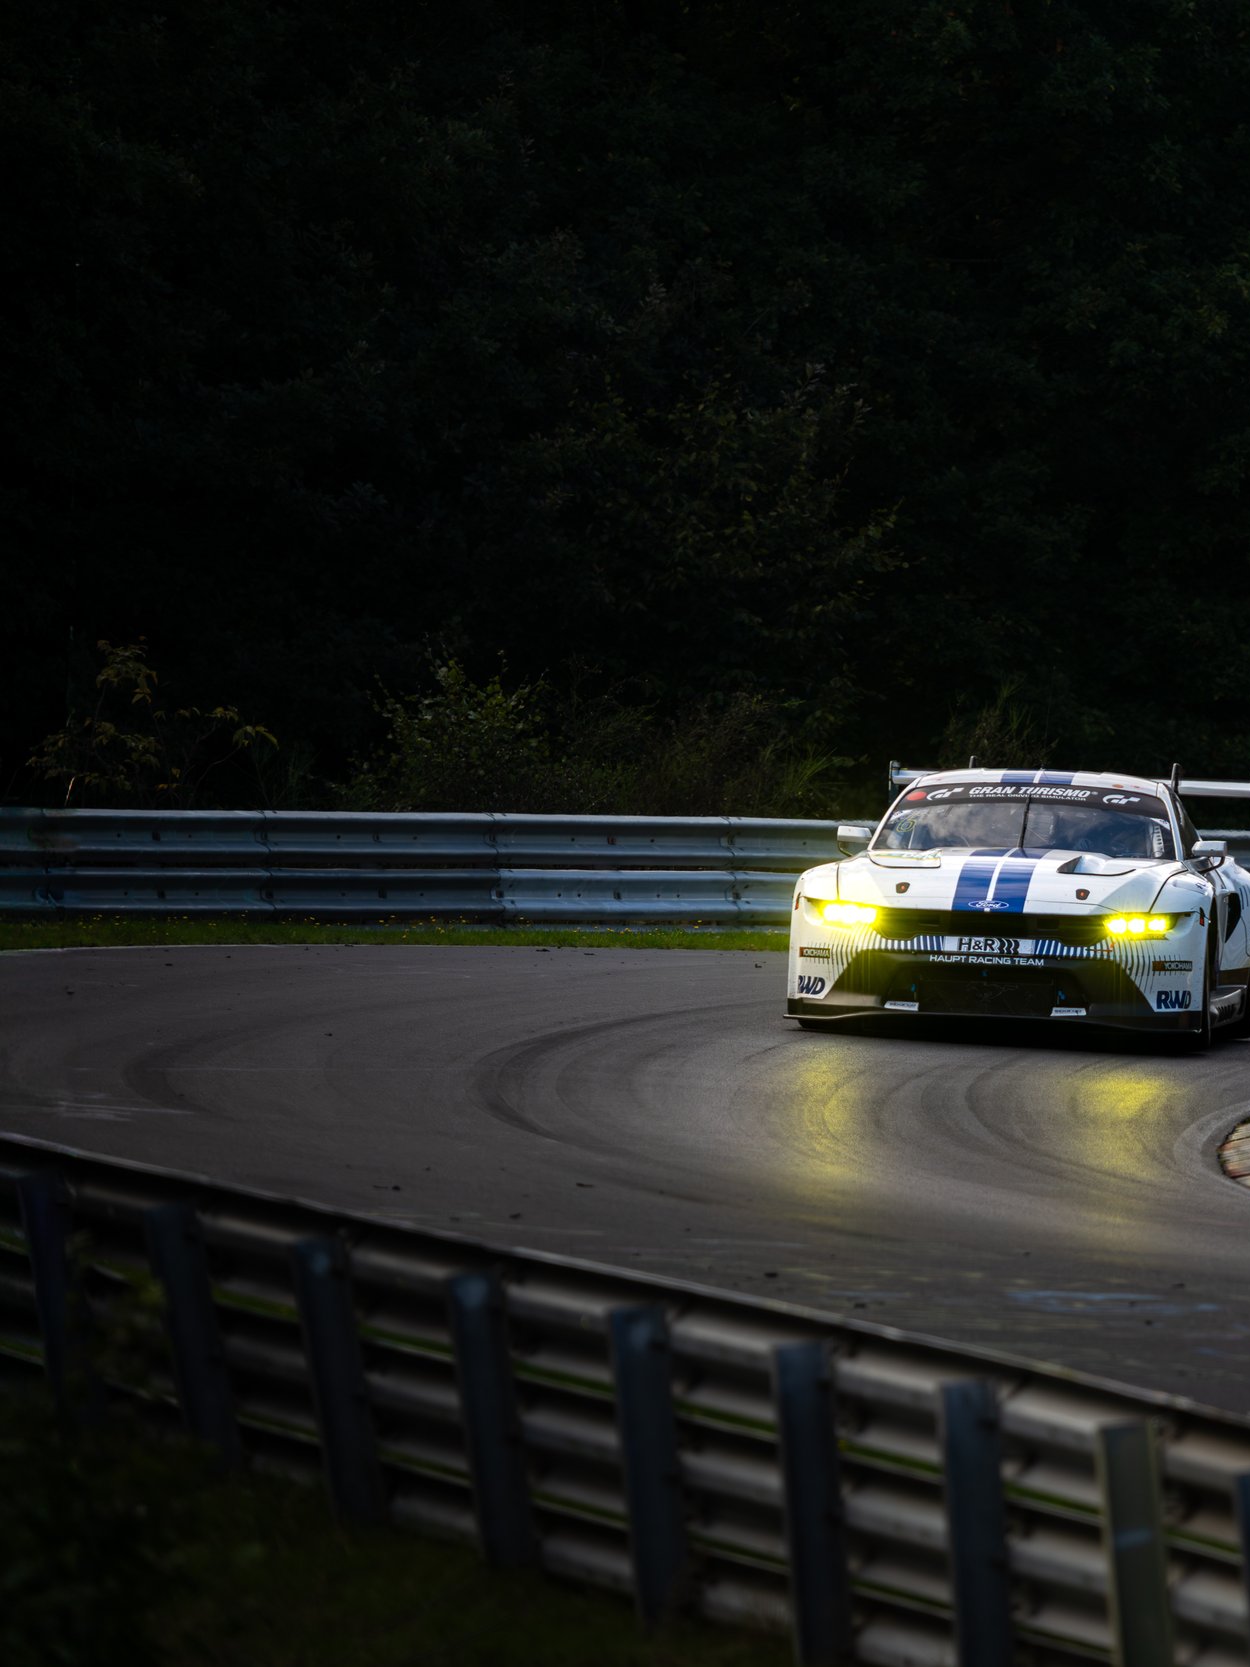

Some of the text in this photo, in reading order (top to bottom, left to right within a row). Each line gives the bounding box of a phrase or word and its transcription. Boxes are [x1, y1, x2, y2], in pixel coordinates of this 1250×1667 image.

[969, 786, 1091, 798] GRAN TURISMO
[958, 938, 996, 952] H&R
[929, 954, 1044, 966] HAUPT RACING TEAM
[1157, 990, 1191, 1009] RWD
